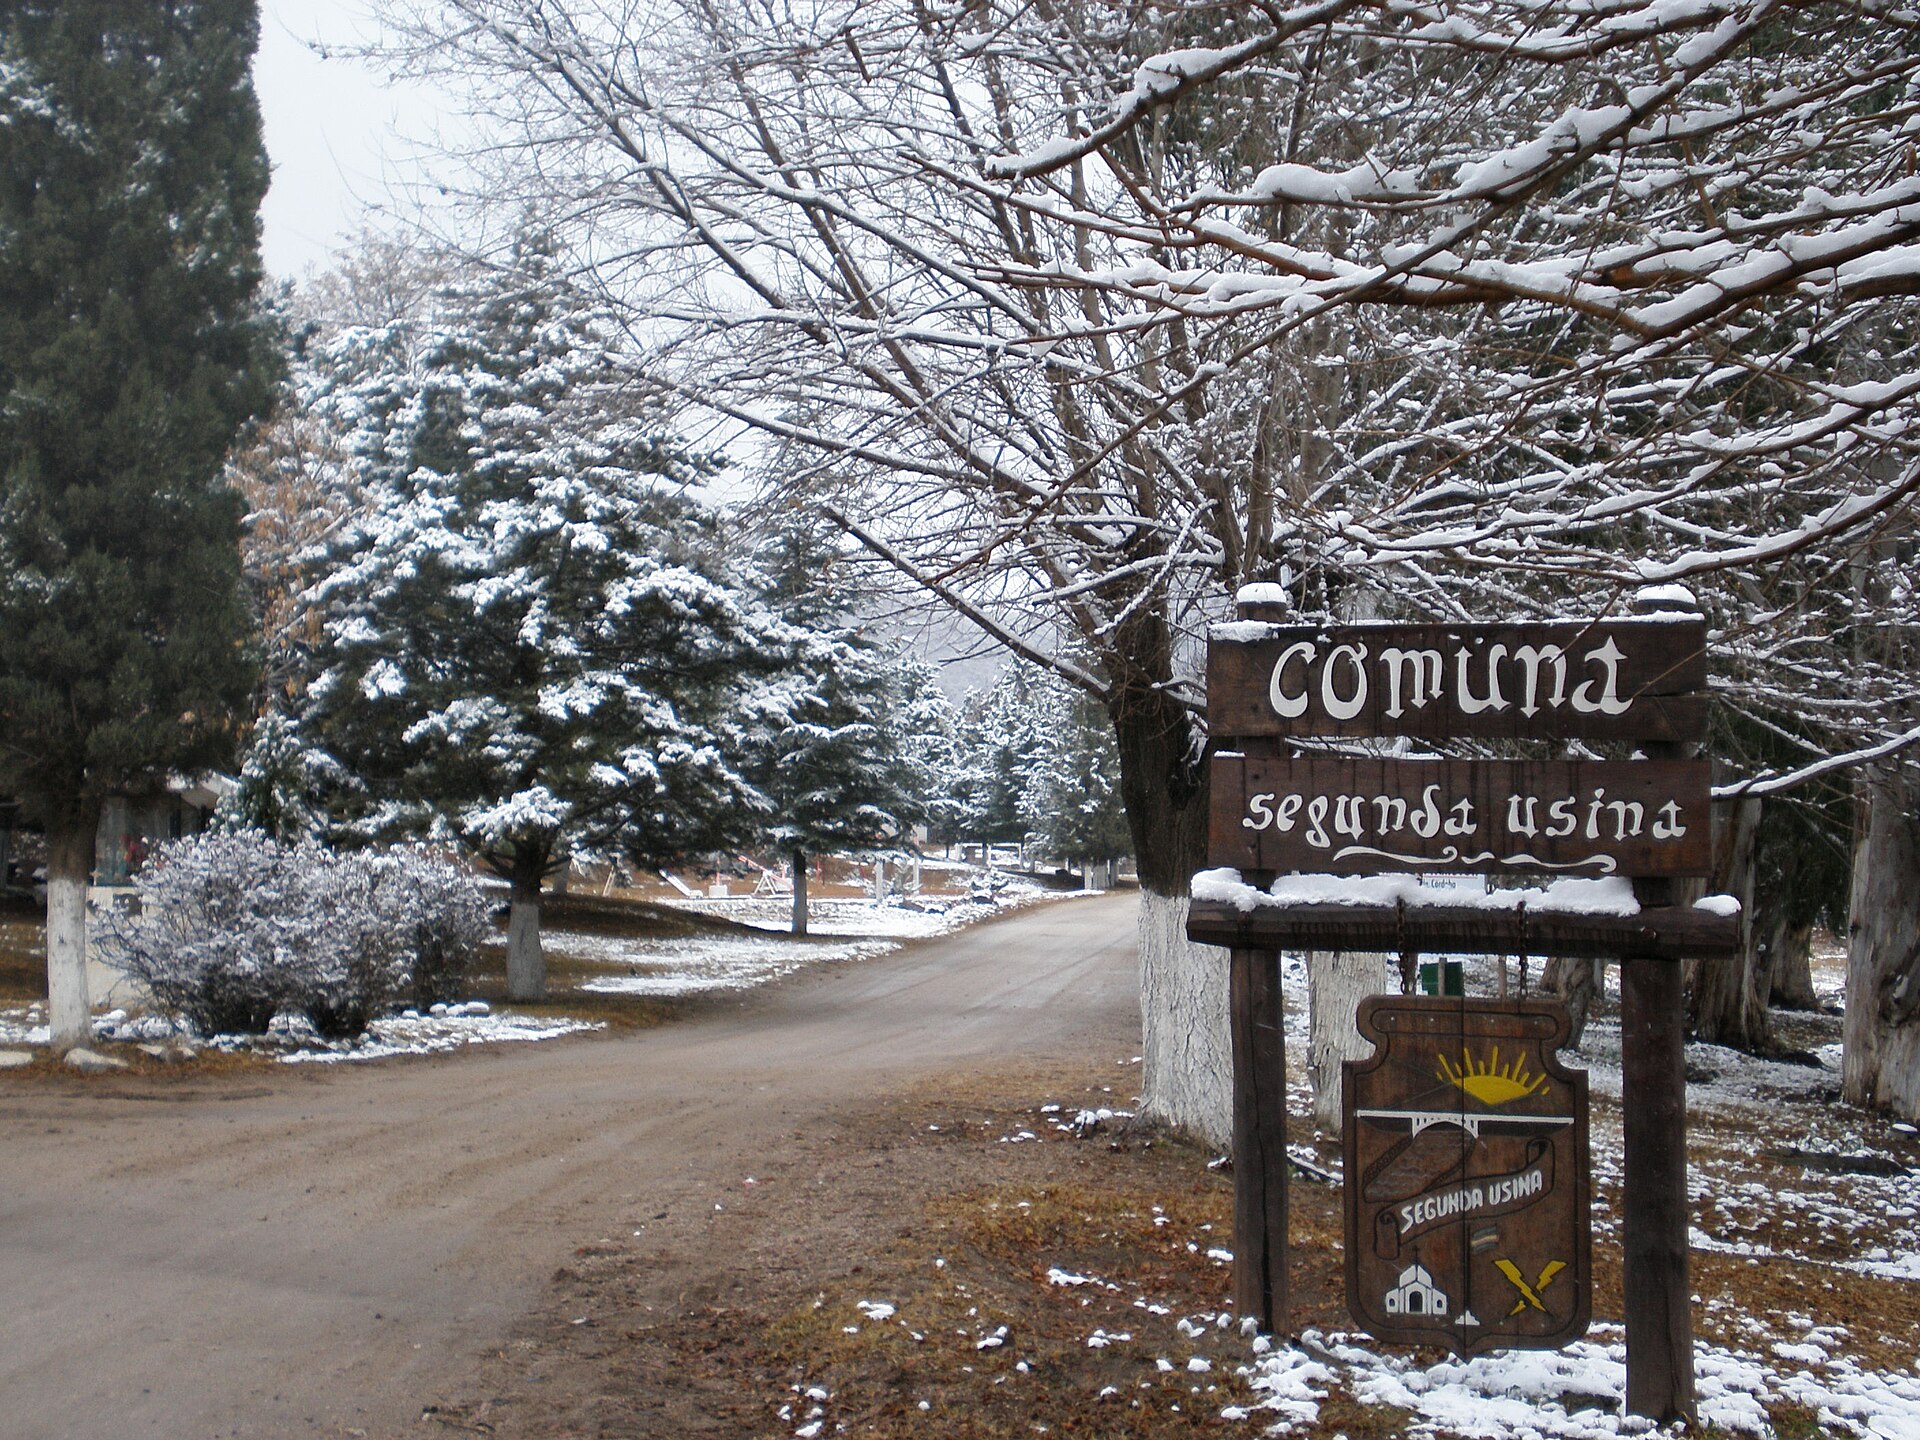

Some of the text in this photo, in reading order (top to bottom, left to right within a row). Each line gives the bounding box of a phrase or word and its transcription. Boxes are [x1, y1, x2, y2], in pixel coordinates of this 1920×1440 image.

[1242, 784, 1688, 848] segunda usina
[1401, 1170, 1542, 1234] SEGUNDA USINA
